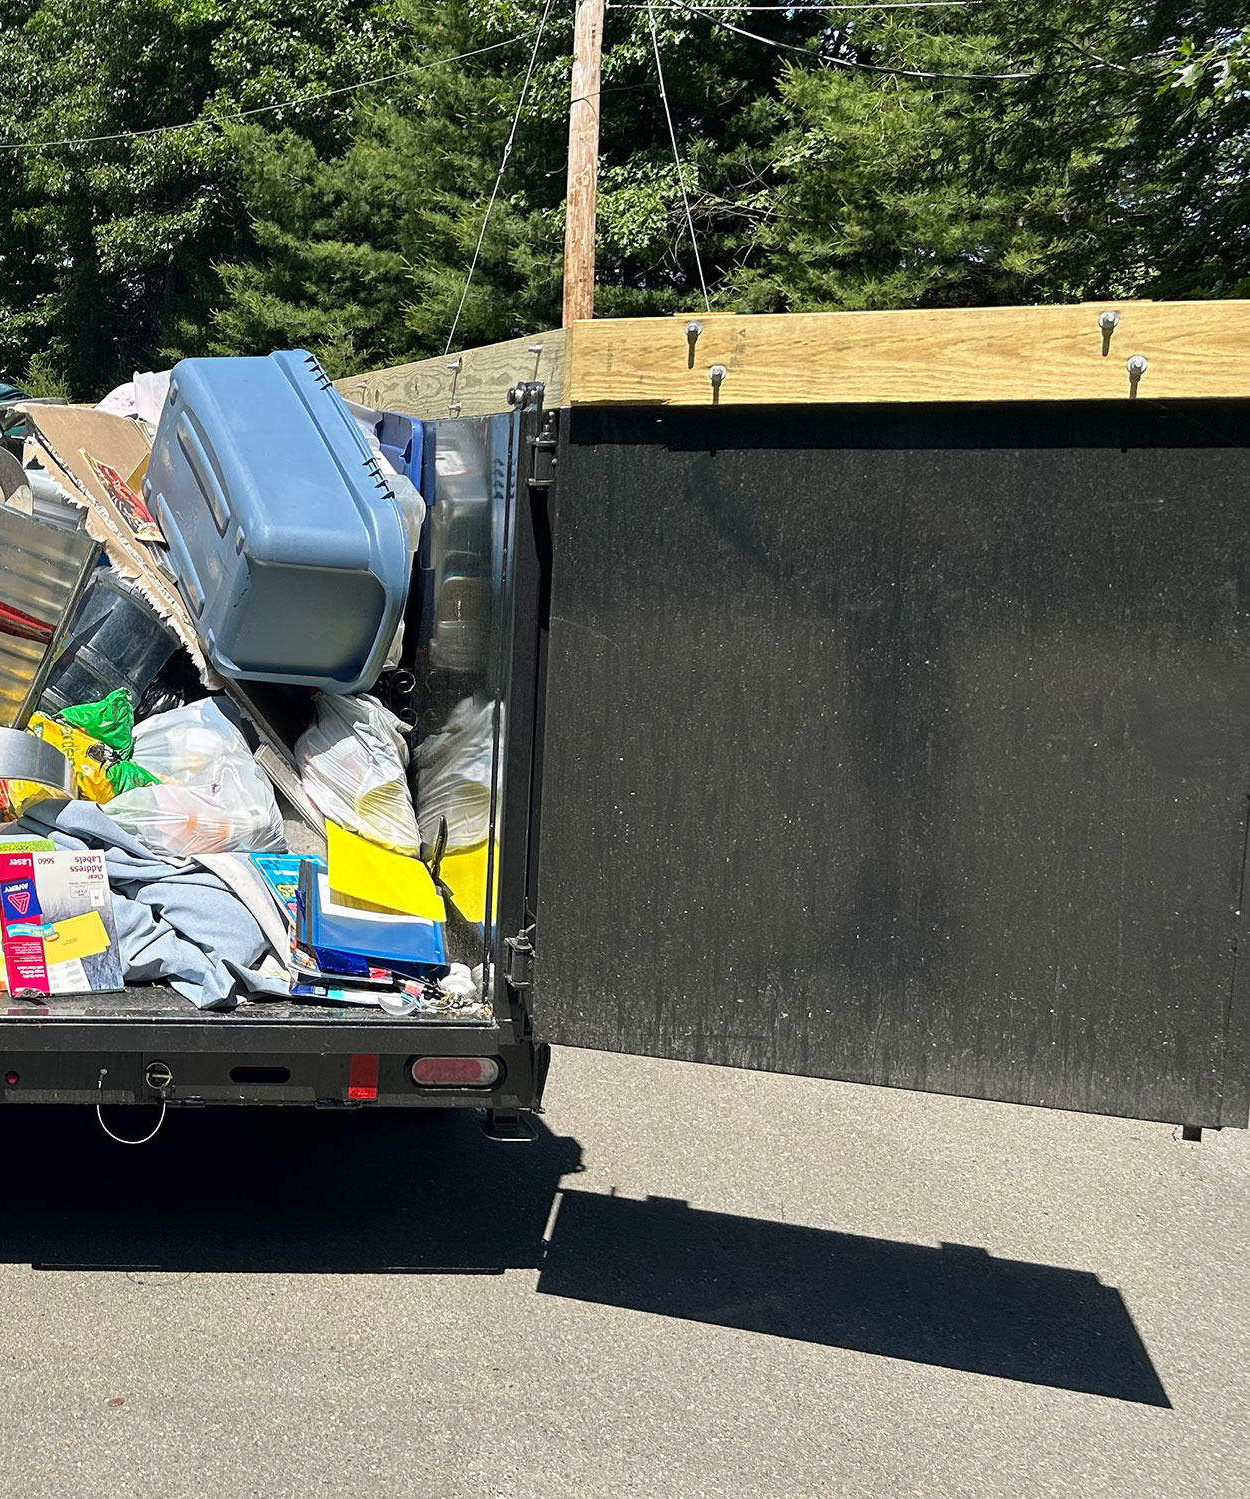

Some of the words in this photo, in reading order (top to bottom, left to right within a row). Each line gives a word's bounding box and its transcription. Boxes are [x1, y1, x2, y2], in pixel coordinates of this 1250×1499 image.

[9, 857, 32, 867] Laser
[75, 855, 102, 863] Labels
[70, 864, 102, 873] Address
[3, 882, 29, 893] AVERY
